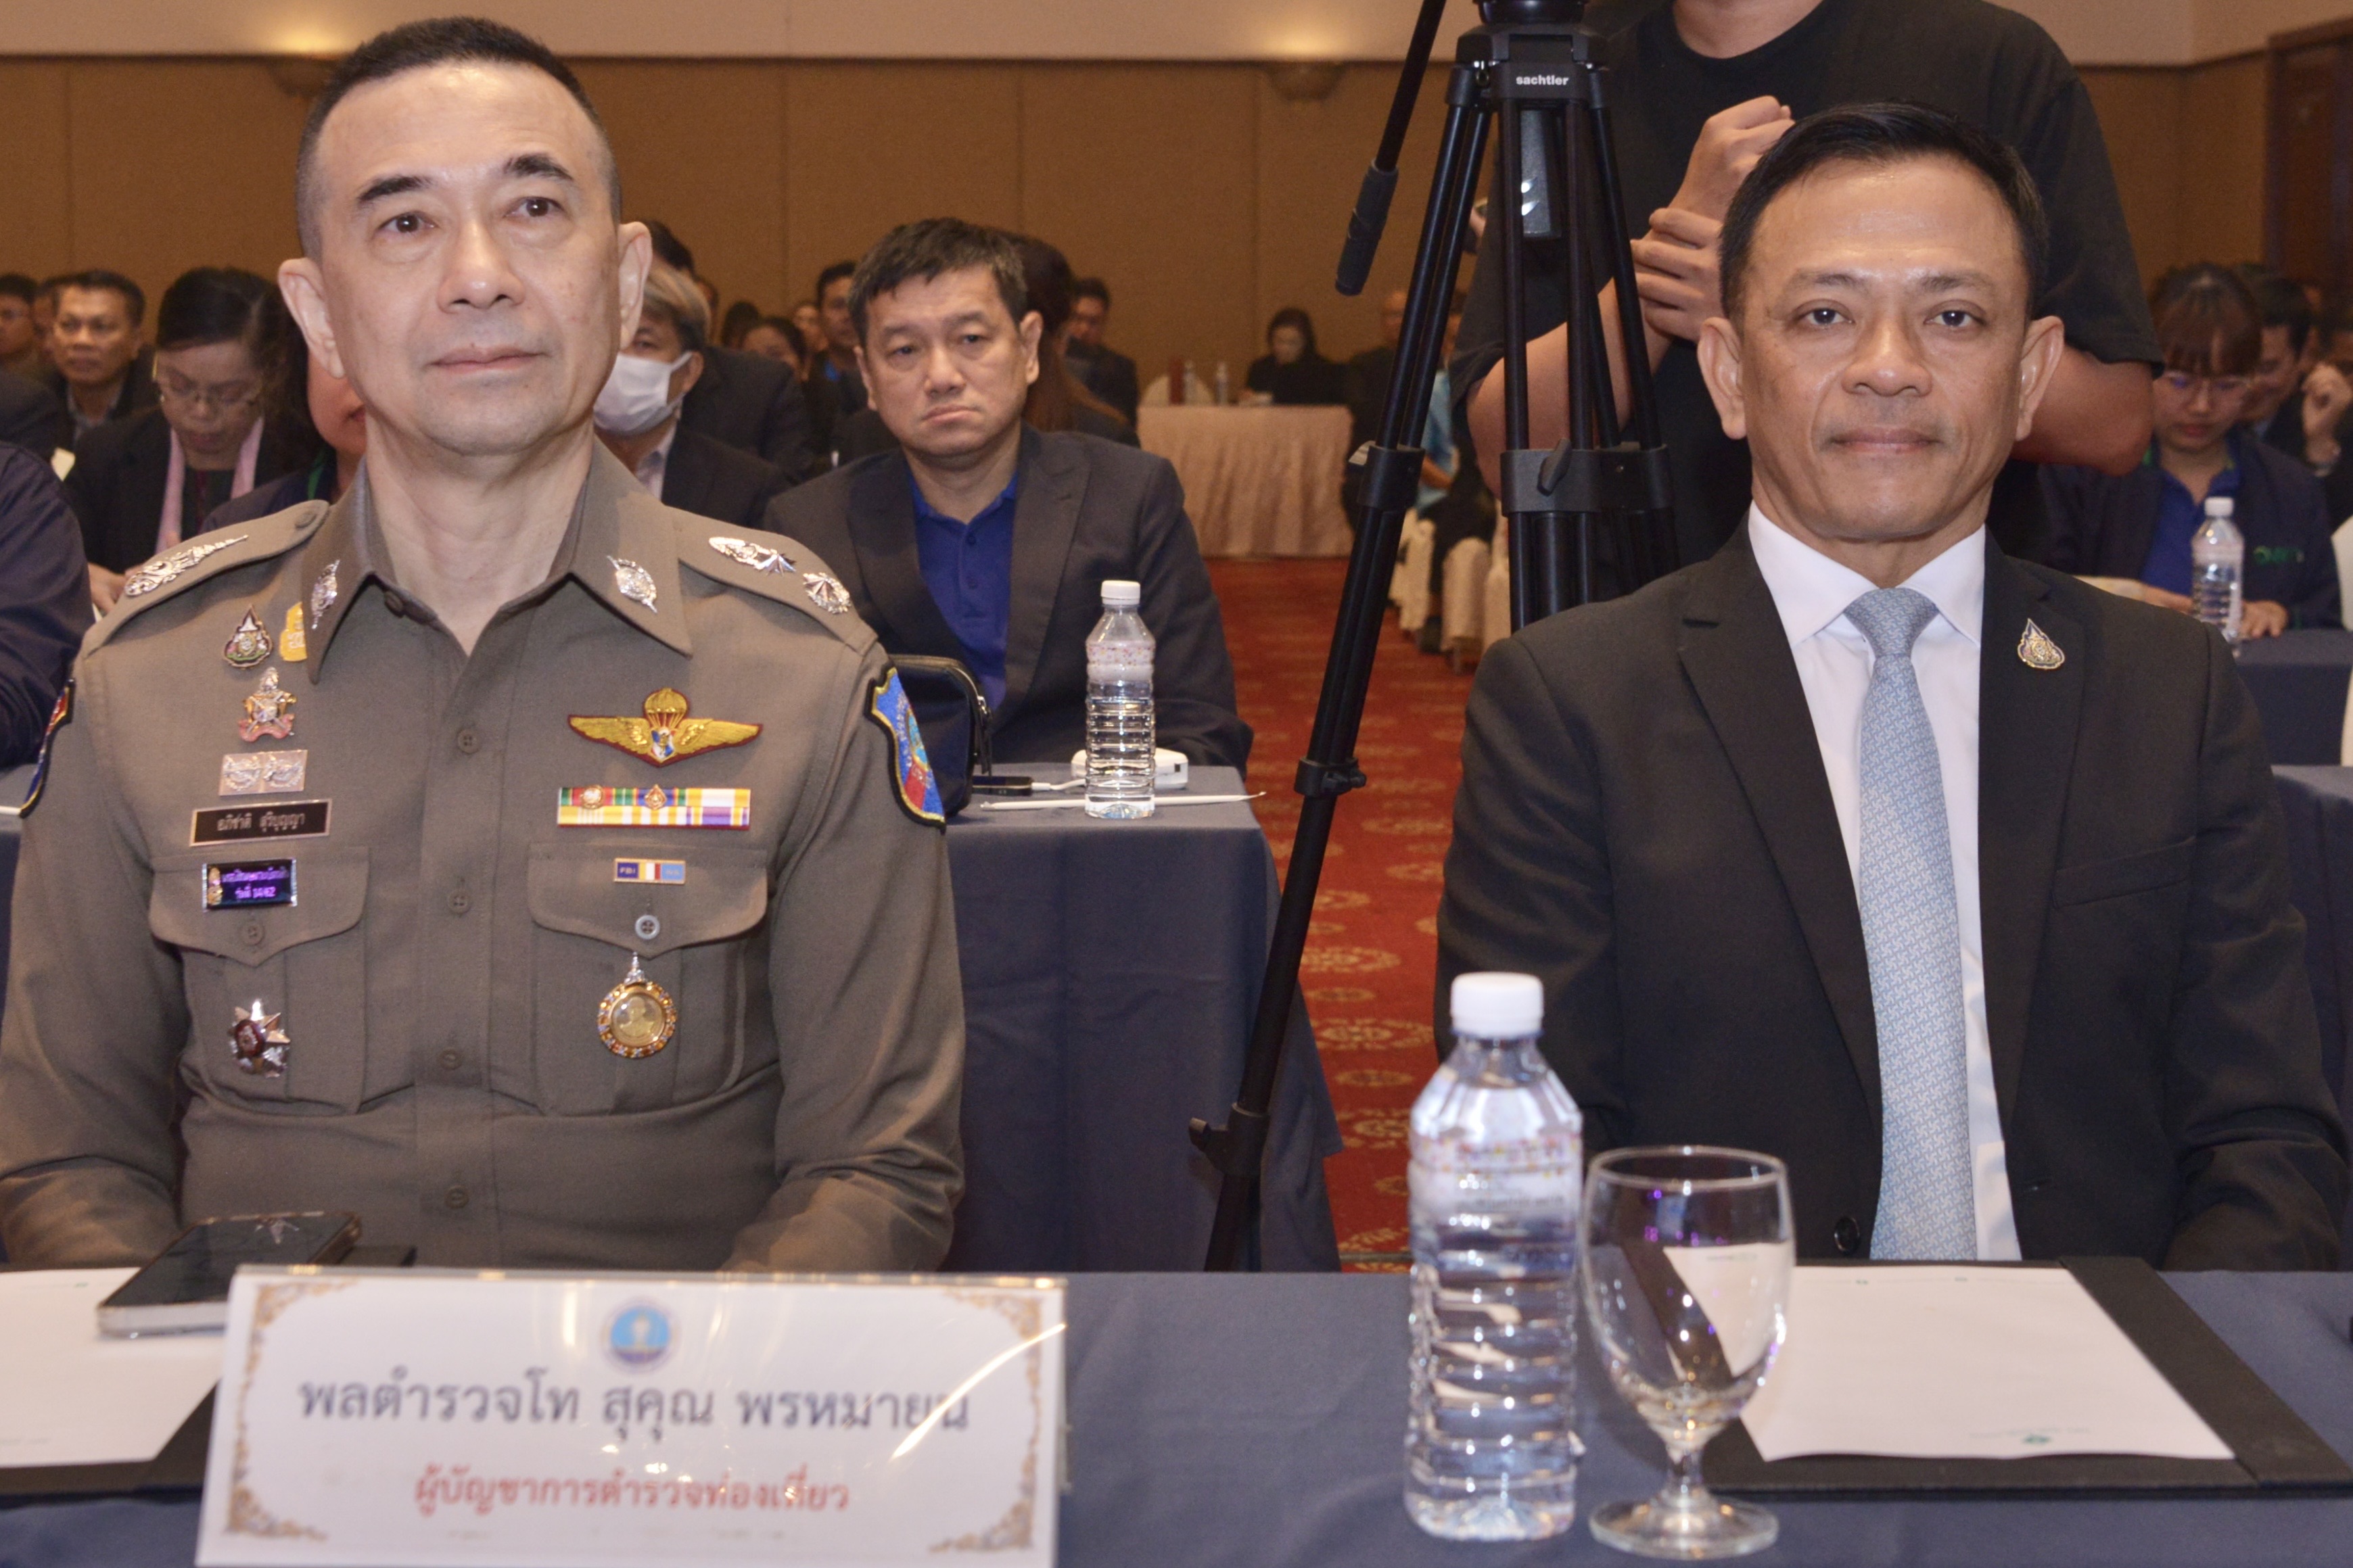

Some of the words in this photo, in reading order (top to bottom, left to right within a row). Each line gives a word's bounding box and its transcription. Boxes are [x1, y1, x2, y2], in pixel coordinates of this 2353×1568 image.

[1516, 74, 1569, 85] sachtler
[298, 1364, 580, 1422] พลตำรวจโท
[603, 1385, 714, 1442] สุคุณ
[736, 1388, 969, 1430] พรหมายน
